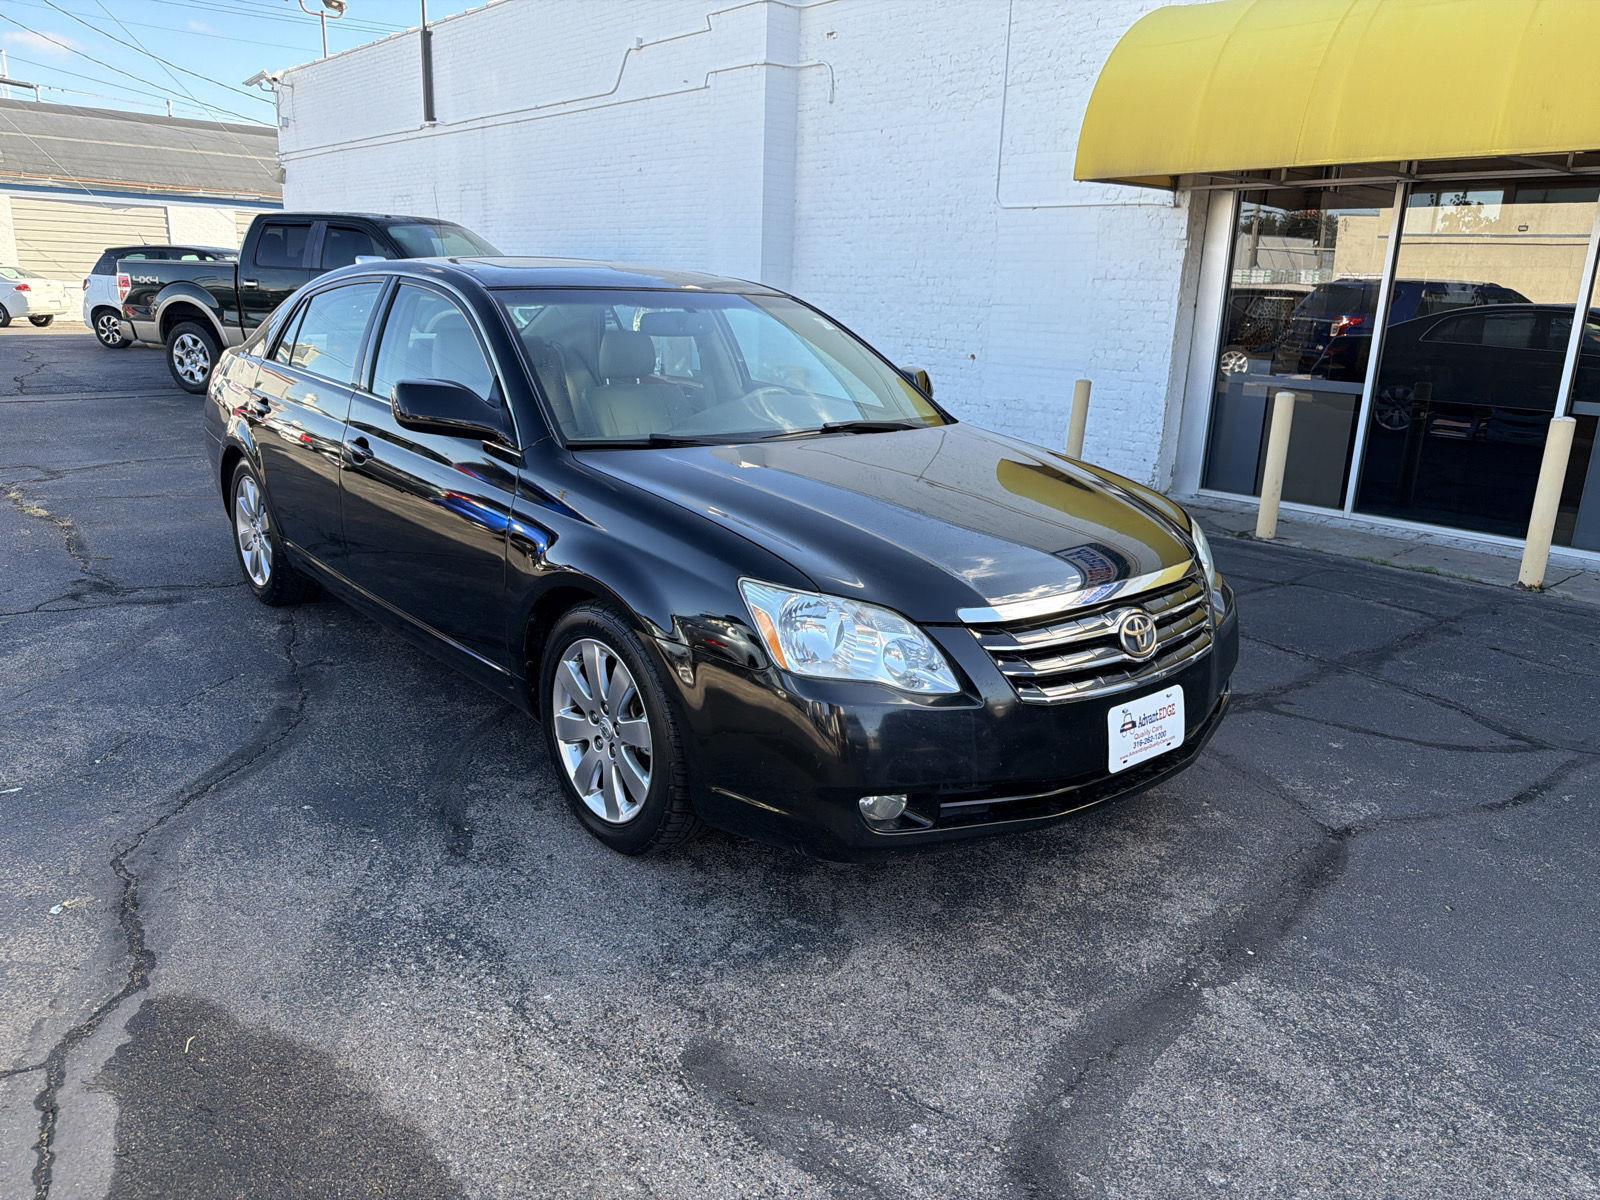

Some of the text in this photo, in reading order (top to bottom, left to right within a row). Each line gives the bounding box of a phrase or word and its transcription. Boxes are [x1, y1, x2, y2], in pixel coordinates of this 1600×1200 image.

[1138, 703, 1176, 728] AdvantEDGE
[1134, 725, 1163, 740] Quality Cars
